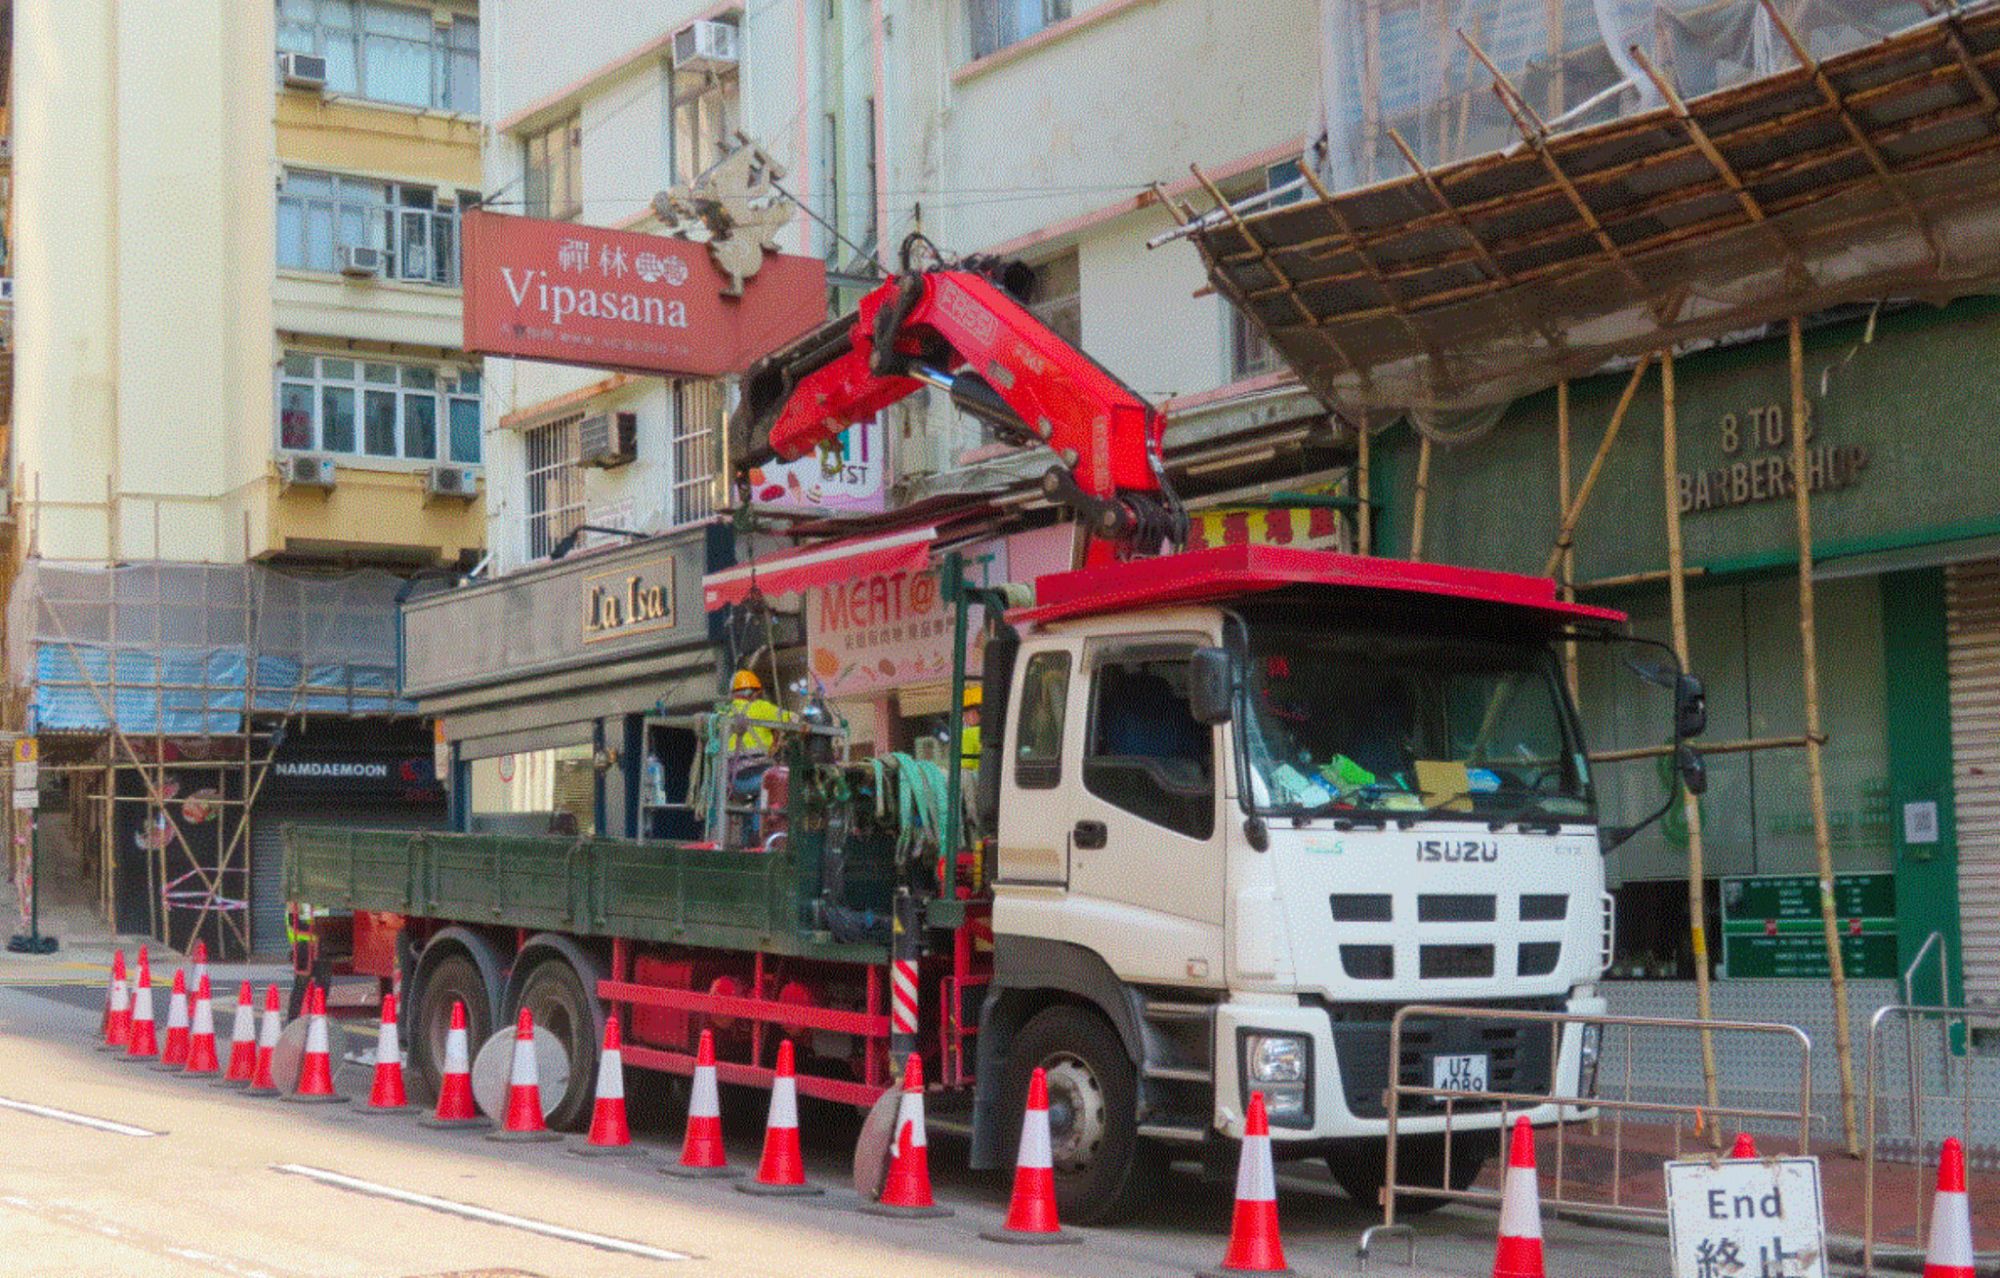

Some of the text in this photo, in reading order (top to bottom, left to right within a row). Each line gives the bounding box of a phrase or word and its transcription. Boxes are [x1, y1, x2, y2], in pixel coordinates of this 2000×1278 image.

[500, 266, 689, 328] Vipasana
[1721, 413, 1738, 452] 8
[1749, 404, 1784, 449] TO
[275, 763, 387, 777] NAMDAEMOON
[1416, 841, 1498, 863] ISUZU
[1449, 1058, 1471, 1077] UZ
[1440, 1077, 1483, 1092] 4089
[1707, 1186, 1783, 1219] End
[1696, 1236, 1799, 1278] 終止
